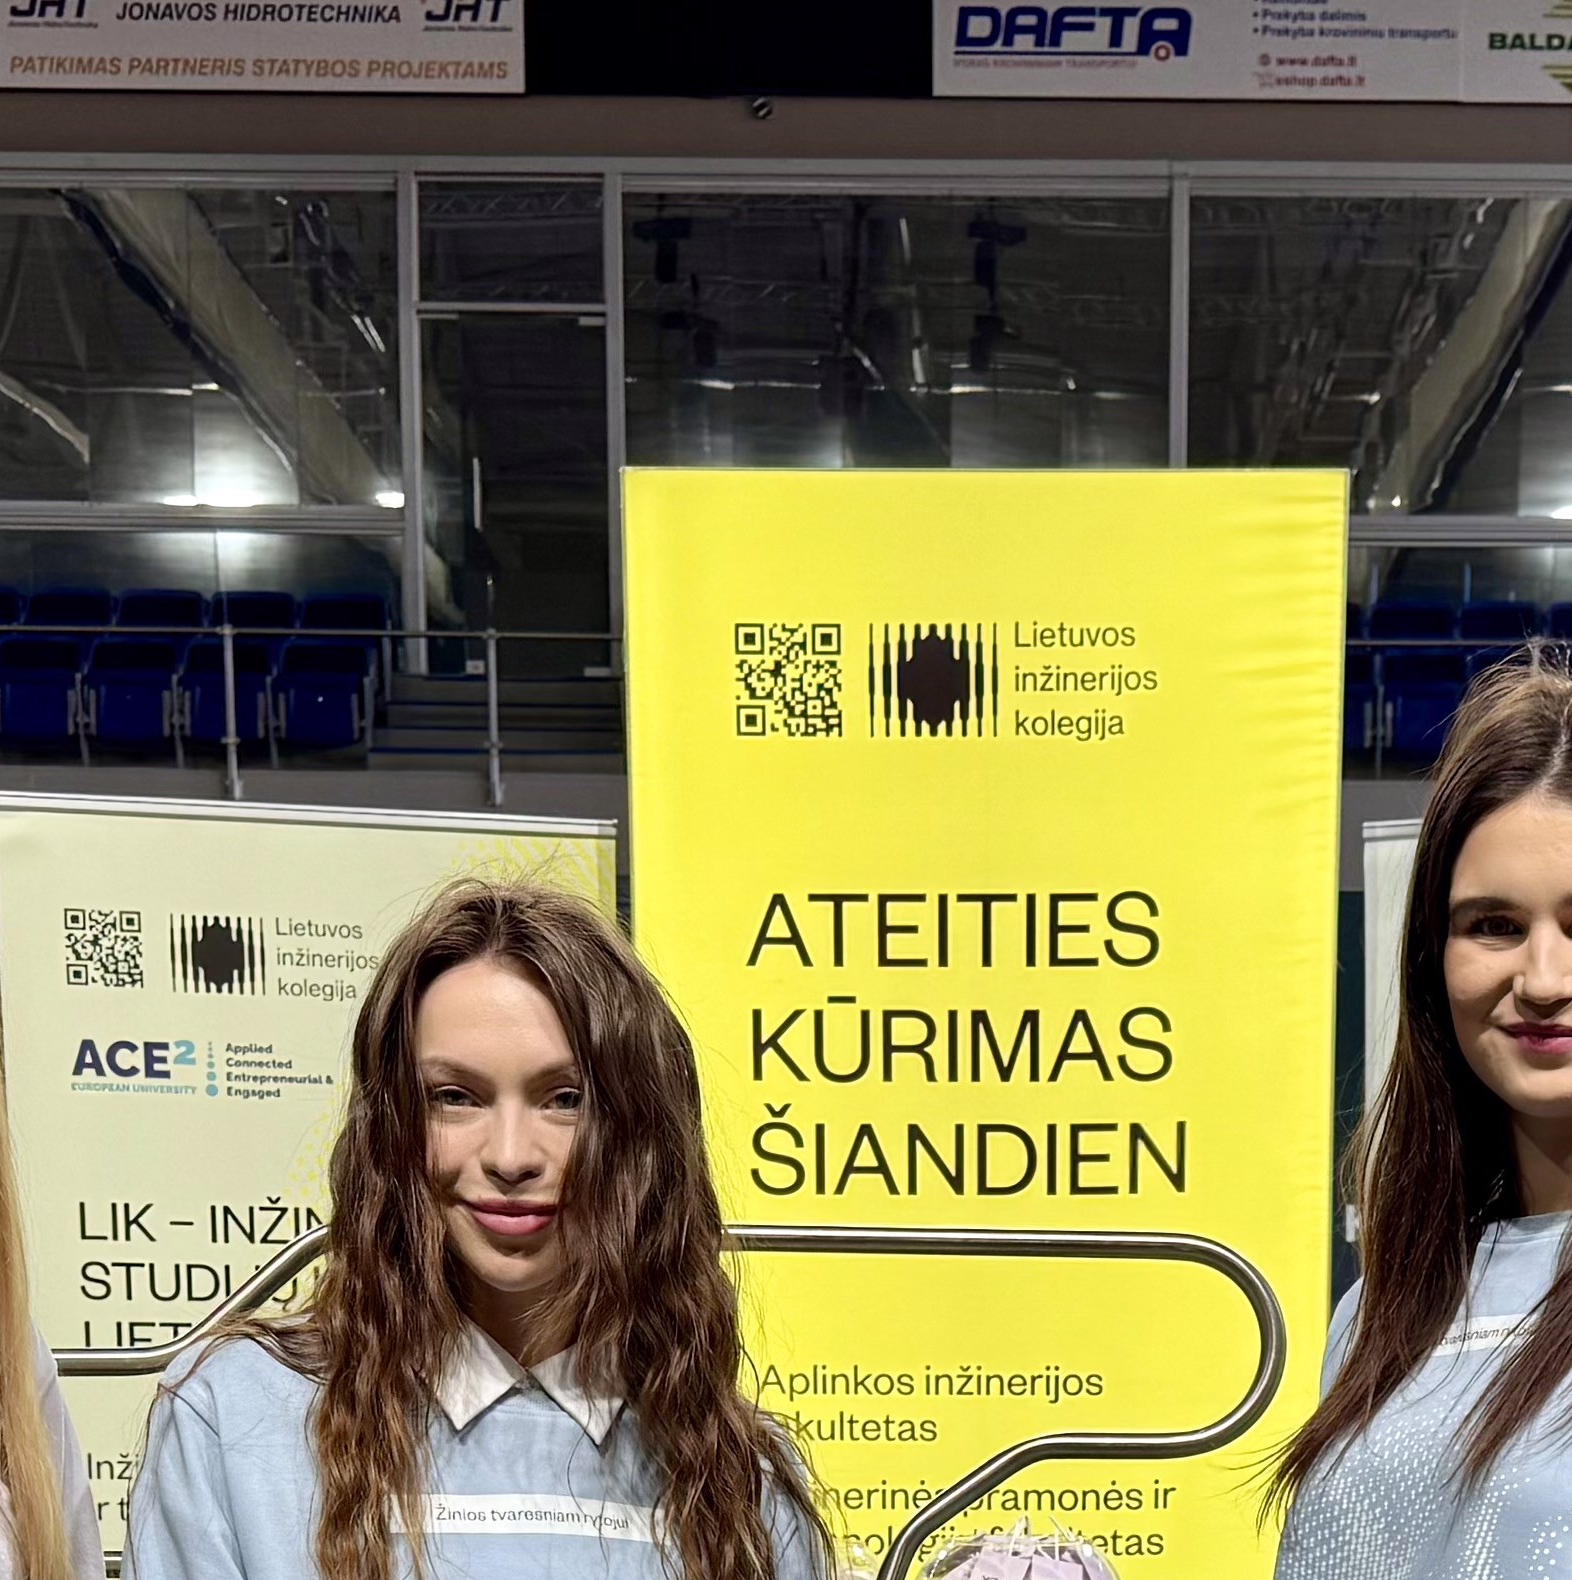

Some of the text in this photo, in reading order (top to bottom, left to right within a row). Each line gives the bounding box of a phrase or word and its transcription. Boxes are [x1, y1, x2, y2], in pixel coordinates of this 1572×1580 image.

[115, 1, 402, 24] JONAVOS HIDROTECHNIKA
[955, 6, 1193, 60] DAFTA
[9, 56, 508, 79] PATIKIMAS PARTNERIS STATYBOS PROJEKTAMS
[1013, 620, 1137, 650] Lietuvos
[1013, 664, 1159, 697] inžinerijos
[1014, 709, 1126, 742] kolegija
[274, 917, 364, 940] Lietuvos
[745, 890, 1162, 969] ATEITIES
[276, 946, 379, 973] inžinerijos
[277, 977, 358, 1002] kolegija
[226, 1043, 273, 1055] Applied
[749, 995, 1175, 1084] KŪRIMAS
[225, 1058, 293, 1069] Connected
[226, 1072, 323, 1085] Entrepreneurial
[226, 1086, 281, 1099] Engaged
[749, 1102, 1189, 1197] ŠIANDIEN
[79, 1201, 158, 1243] LIK
[759, 1364, 1105, 1404] Aplinkos inžinerijos
[793, 1411, 938, 1443] kultetas
[1153, 1479, 1177, 1511] ir
[435, 1503, 487, 1521] Žinios
